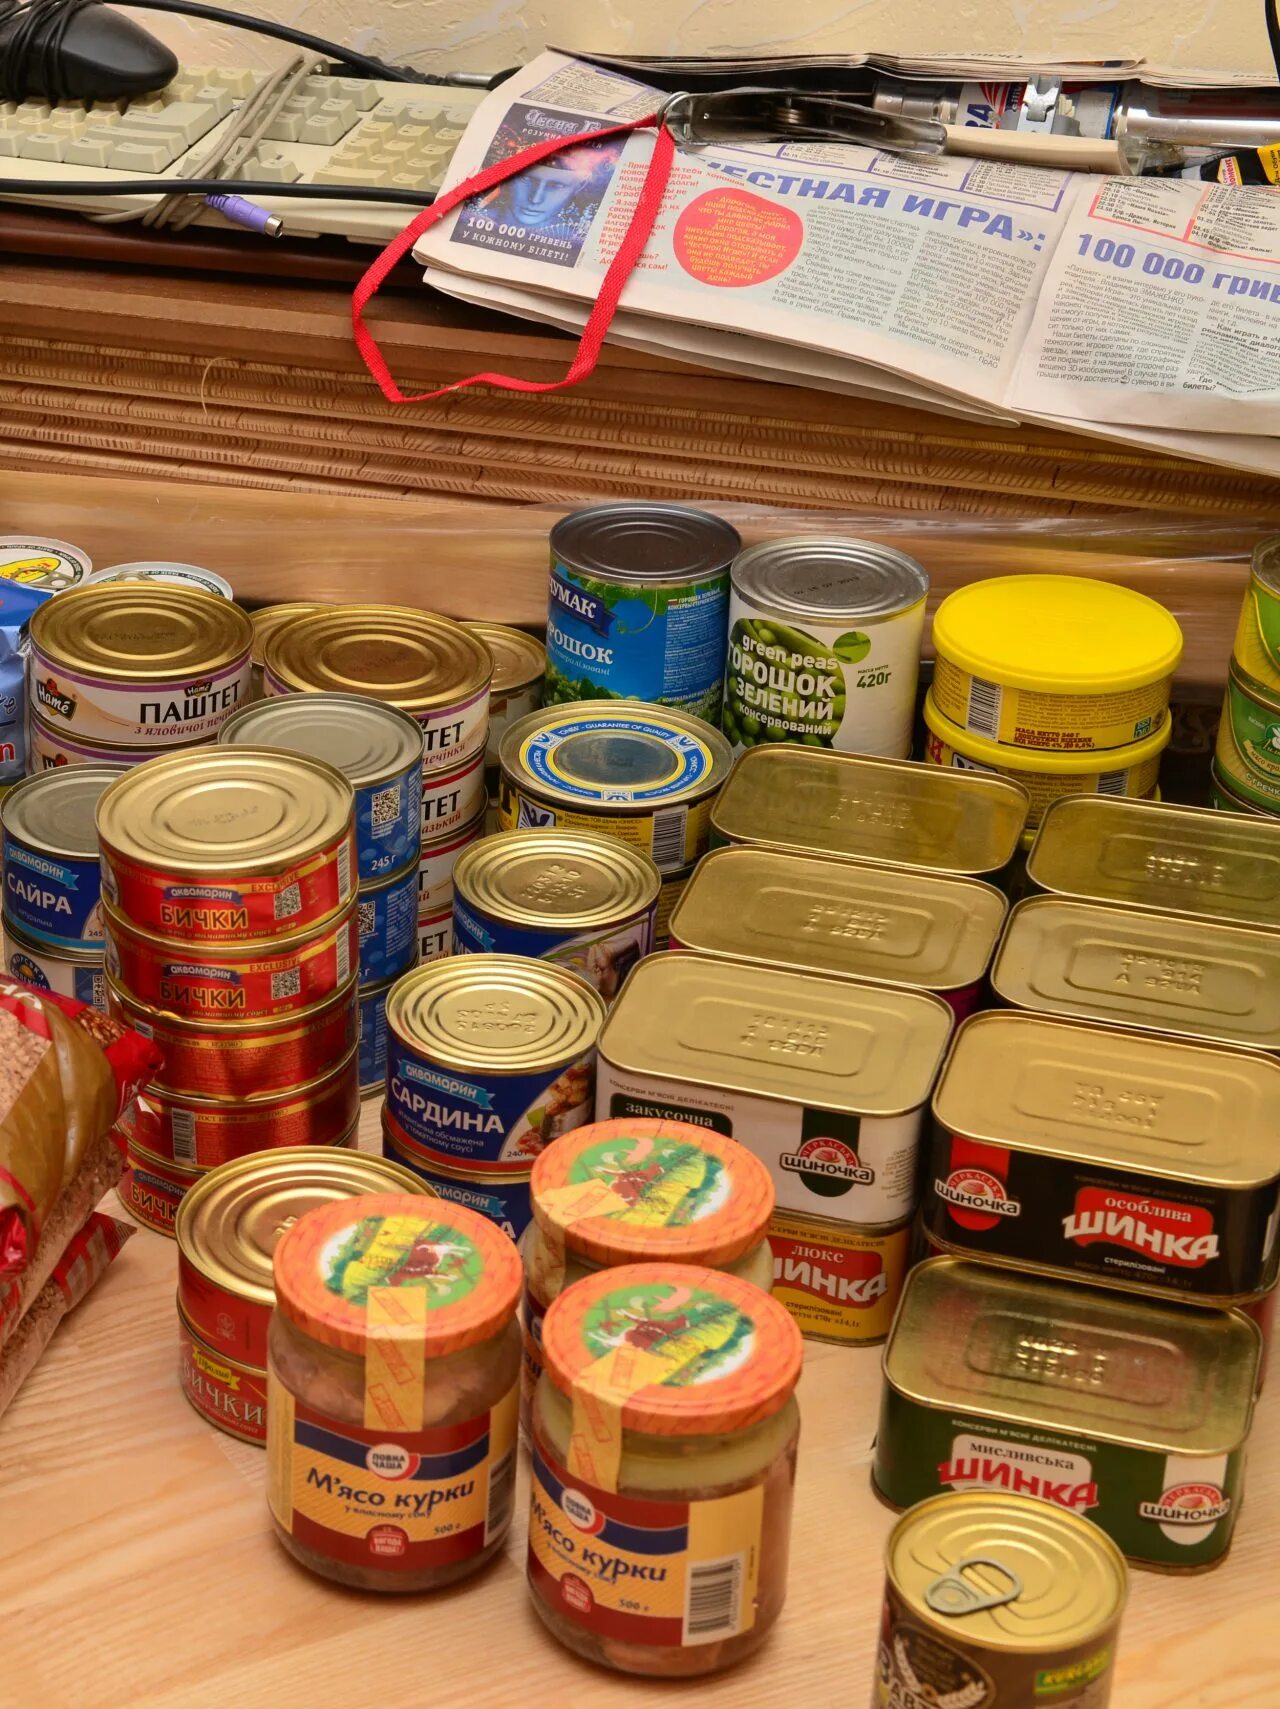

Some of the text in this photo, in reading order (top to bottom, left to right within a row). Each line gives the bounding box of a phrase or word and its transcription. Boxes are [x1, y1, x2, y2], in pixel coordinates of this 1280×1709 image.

[467, 217, 572, 248] 100 000 ГРИВЕНЬ
[894, 193, 1046, 252] ИГРА»:
[472, 232, 526, 251] КОЖНОМУ
[528, 246, 569, 261] БІЛЕТІ!
[1078, 233, 1136, 269] 100
[1142, 252, 1205, 284] 000
[547, 622, 614, 665] РОШОК
[742, 634, 838, 671] green peas
[728, 640, 837, 698] ГОРОШОК
[857, 671, 892, 689] 420г
[140, 680, 241, 724] ПАШТЕТ
[736, 677, 833, 720] ЗЕЛЕНИЙ
[145, 722, 205, 737] яловичої
[585, 722, 629, 731] GUARANTEE
[642, 726, 671, 740] QUALITY
[739, 704, 832, 735] консервований
[423, 720, 465, 751] ТЕТ
[422, 789, 461, 820] ТЕТ
[371, 856, 389, 870] 245
[7, 872, 72, 915] САЙРА
[171, 888, 232, 900] аквамарин
[251, 871, 299, 893] EXCLUSIVE
[160, 903, 249, 931] БИЧКИ
[171, 965, 231, 980] аквамарин
[250, 957, 300, 972] EXCLUSIVE
[160, 981, 246, 1010] БИЧКИ
[405, 1065, 478, 1099] аквамарин
[391, 1077, 505, 1134] САРДИНА
[626, 1102, 713, 1127] закусочна
[435, 1130, 484, 1147] обсмажена
[785, 1157, 870, 1180] шиночка
[131, 1183, 178, 1218] БИЧК
[431, 1183, 490, 1209] амарин
[936, 1181, 1018, 1214] шиночка
[1105, 1197, 1192, 1223] особлива
[1062, 1210, 1219, 1261] ШИНКА
[1104, 1256, 1166, 1274] стерилізовані
[952, 1419, 998, 1434] КОНСЕРВИ
[1032, 1434, 1097, 1451] ДЕЛІКАТЕСНІ
[372, 1453, 405, 1463] ПОВНА
[372, 1460, 403, 1471] ЧАША
[970, 1442, 1074, 1470] мисливська
[394, 1481, 475, 1511] курки
[937, 1458, 1099, 1509] ШИНКА
[433, 1525, 452, 1535] 500
[583, 1548, 667, 1584] курки
